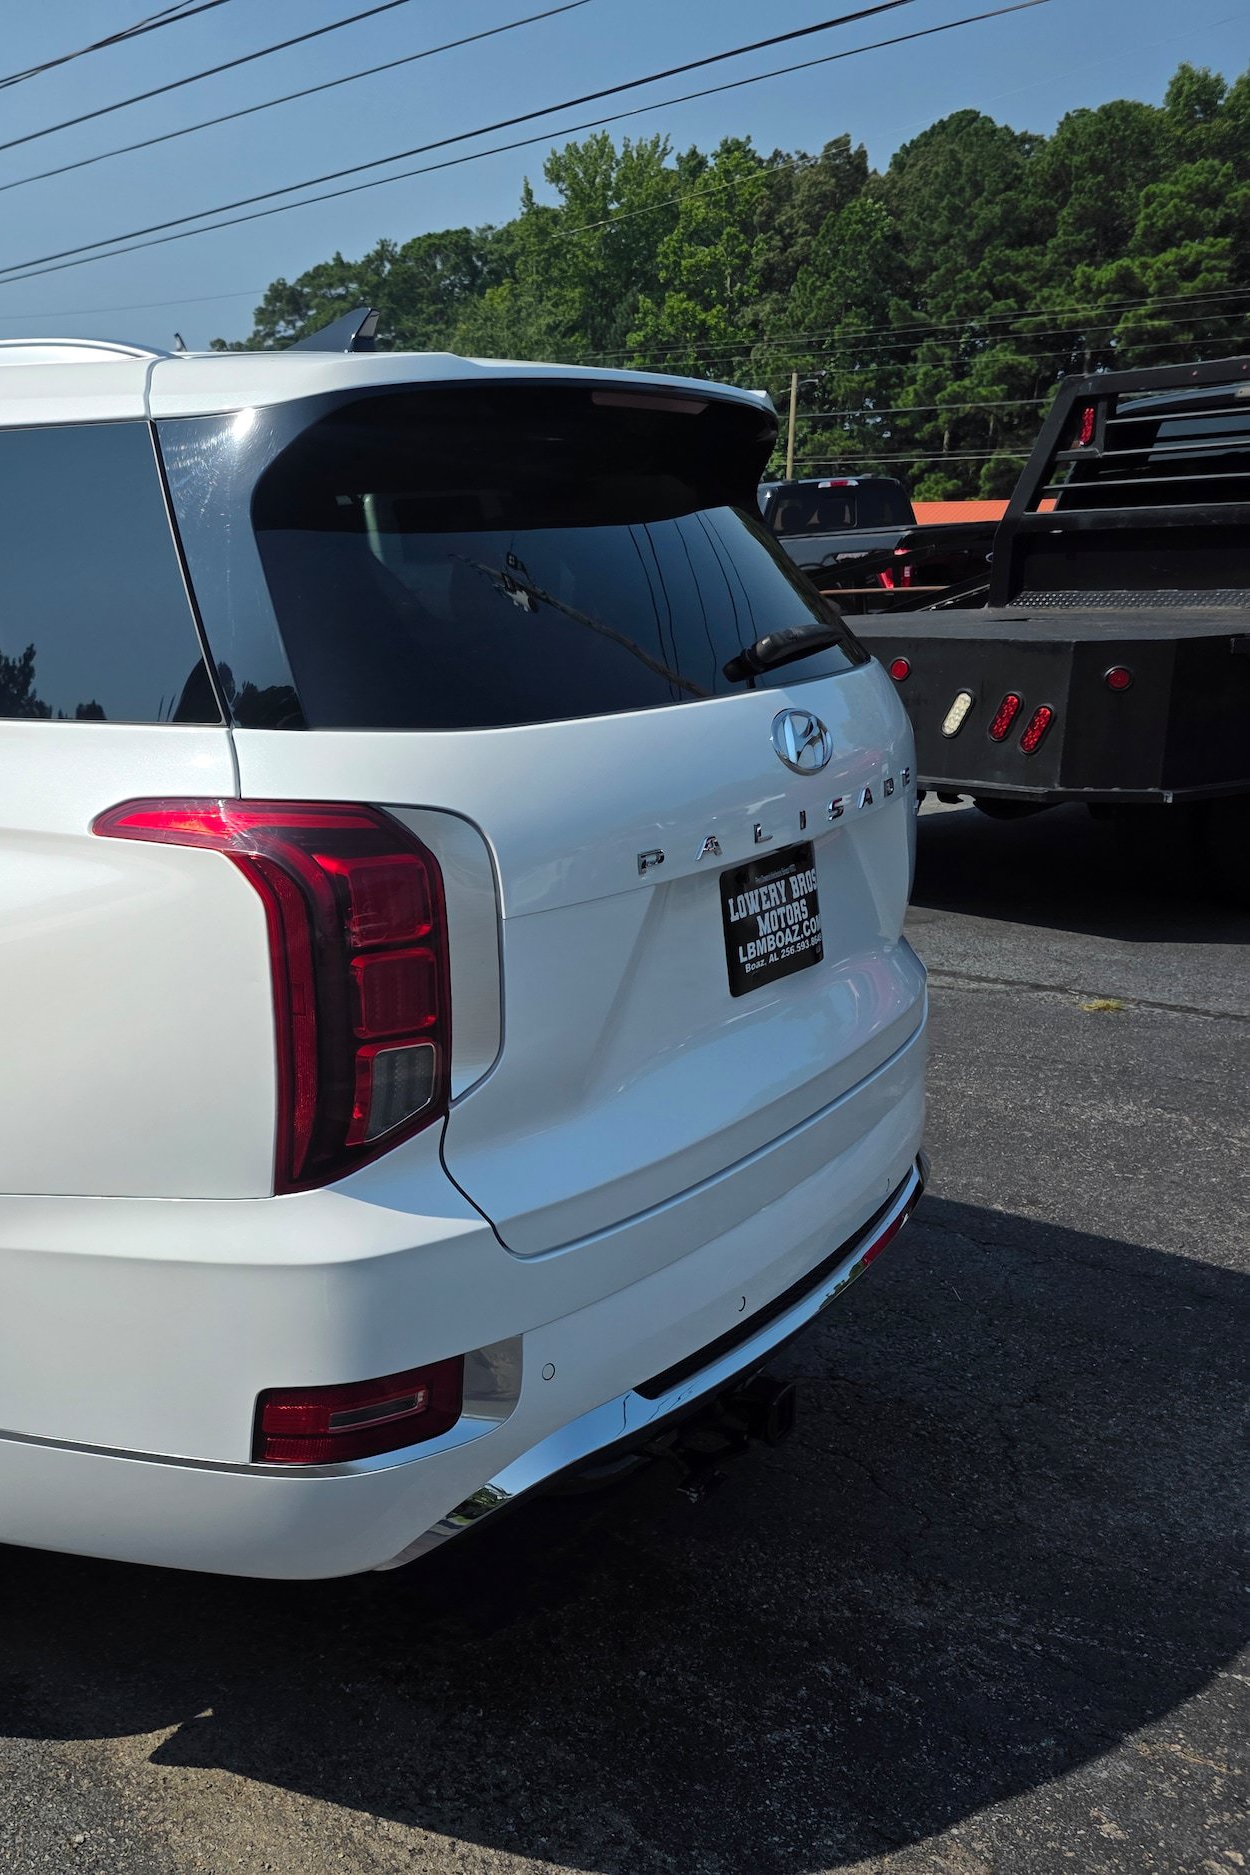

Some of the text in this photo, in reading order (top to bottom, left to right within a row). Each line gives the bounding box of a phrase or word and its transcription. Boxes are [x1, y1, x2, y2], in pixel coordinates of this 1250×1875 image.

[637, 766, 911, 876] PALISADE
[728, 879, 787, 922] LOWERY
[789, 868, 817, 899] BROS
[756, 898, 809, 936] MOTORS
[768, 952, 779, 964] AL
